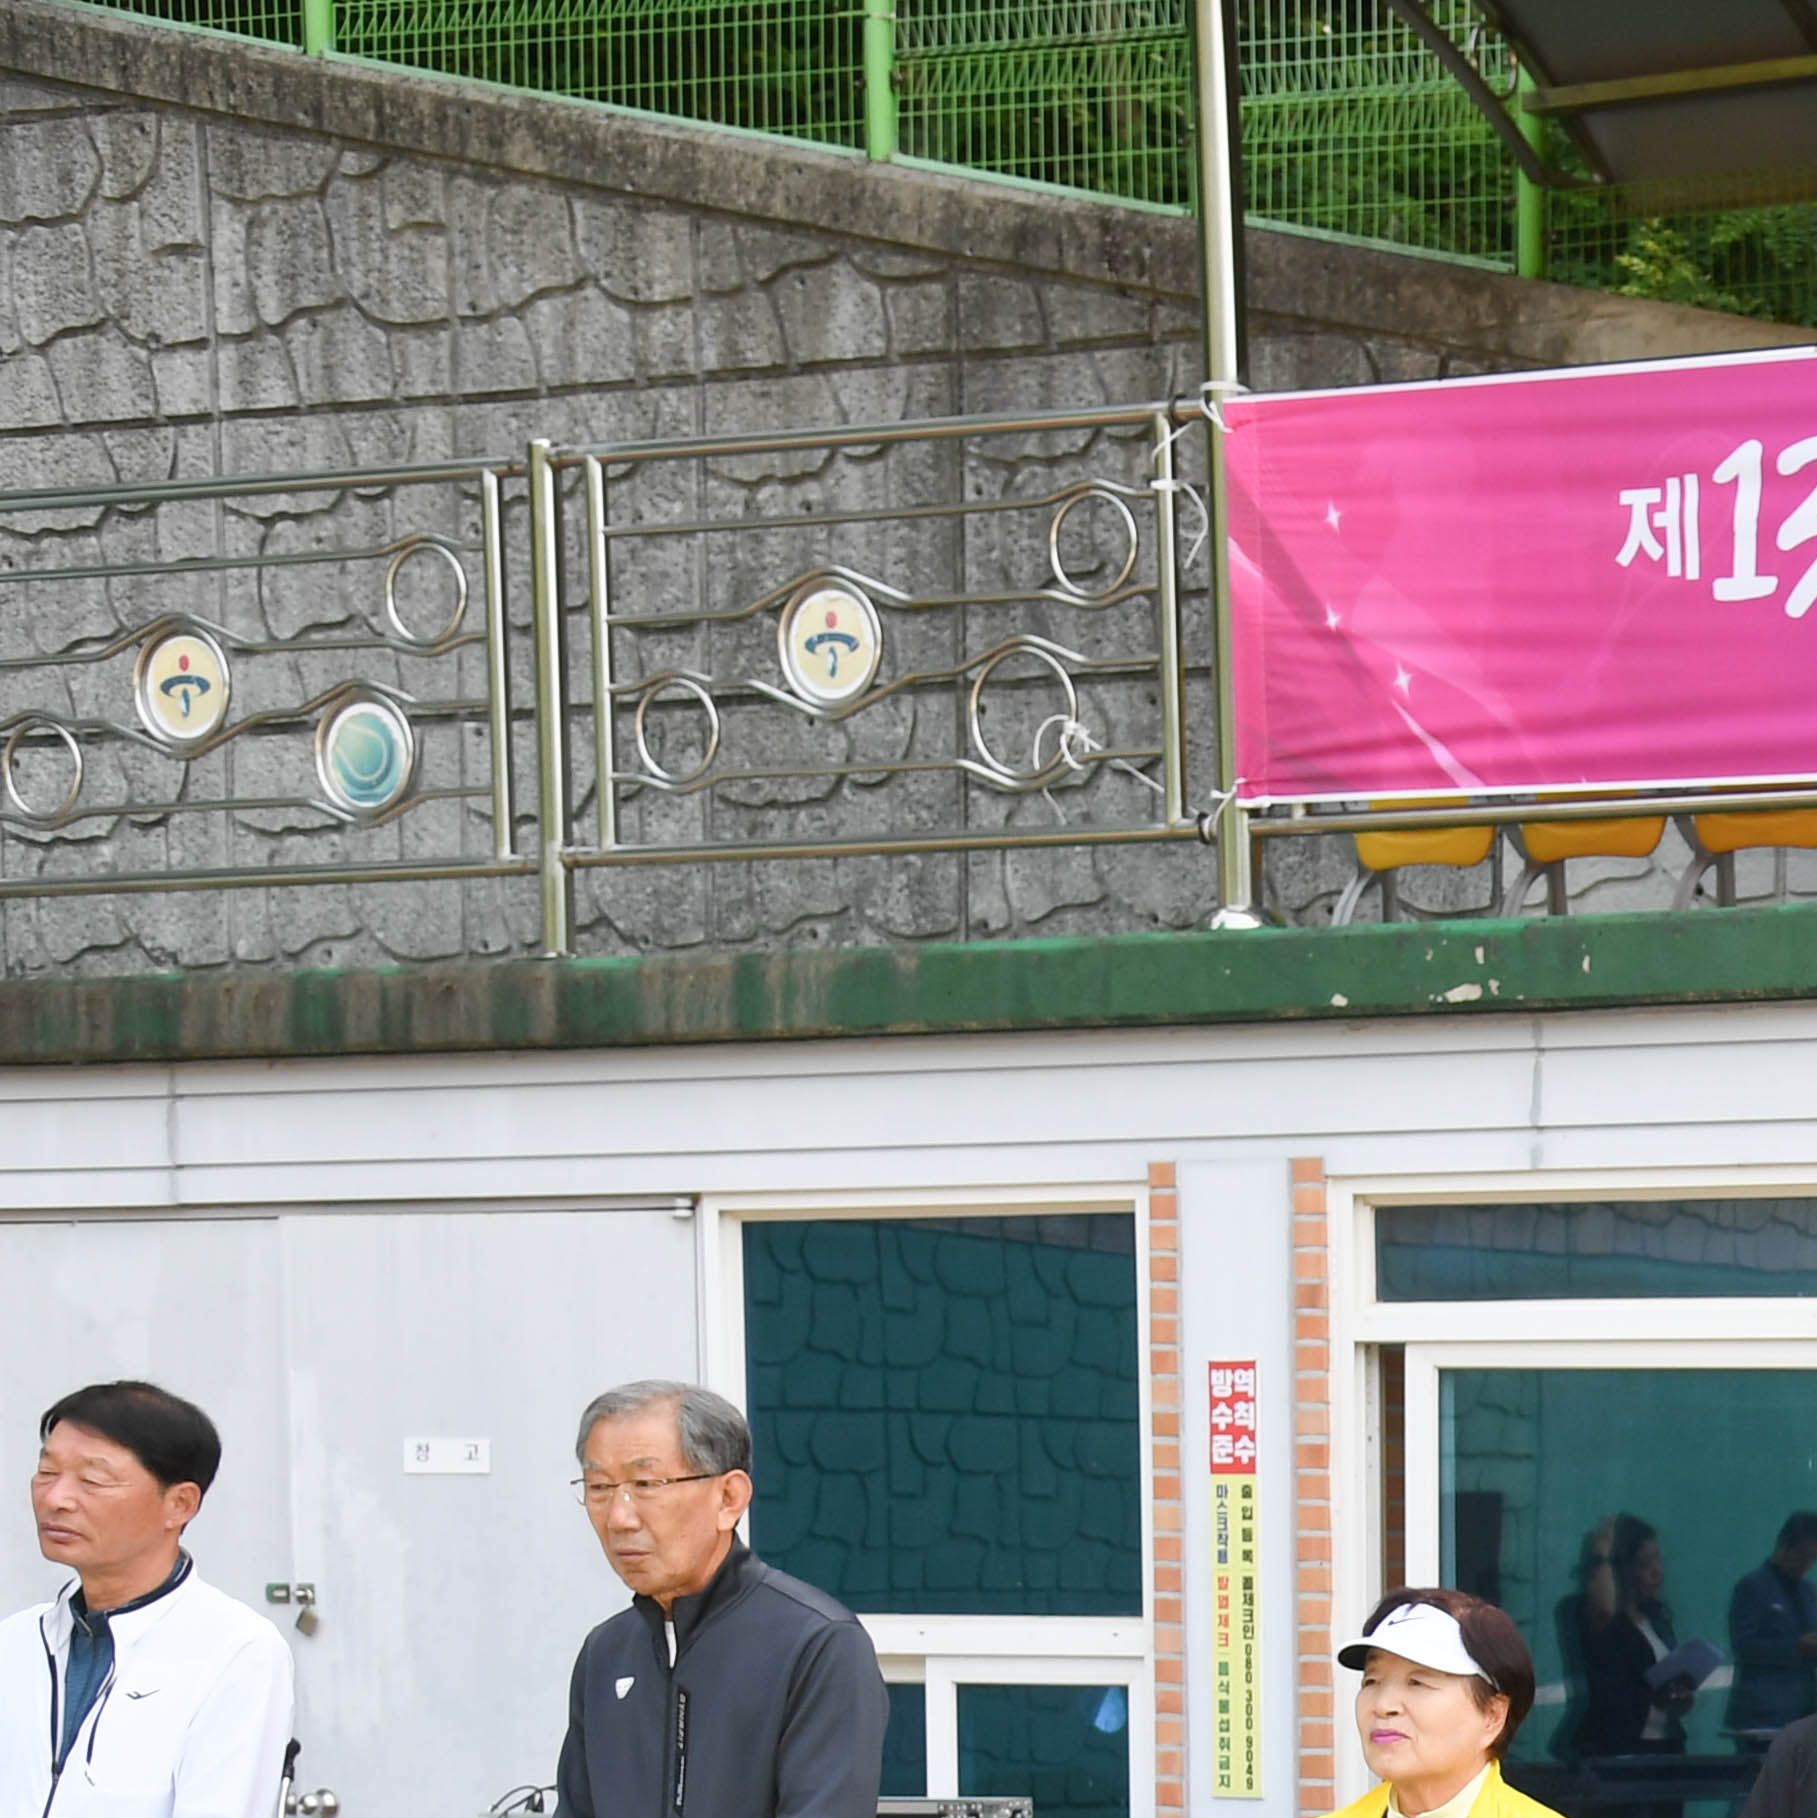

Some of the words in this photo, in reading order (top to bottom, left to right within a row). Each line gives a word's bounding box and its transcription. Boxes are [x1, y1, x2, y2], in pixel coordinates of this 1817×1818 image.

[1211, 1368, 1255, 1398] 방역
[1212, 1401, 1255, 1431] 수칙
[1213, 1434, 1256, 1464] 준수
